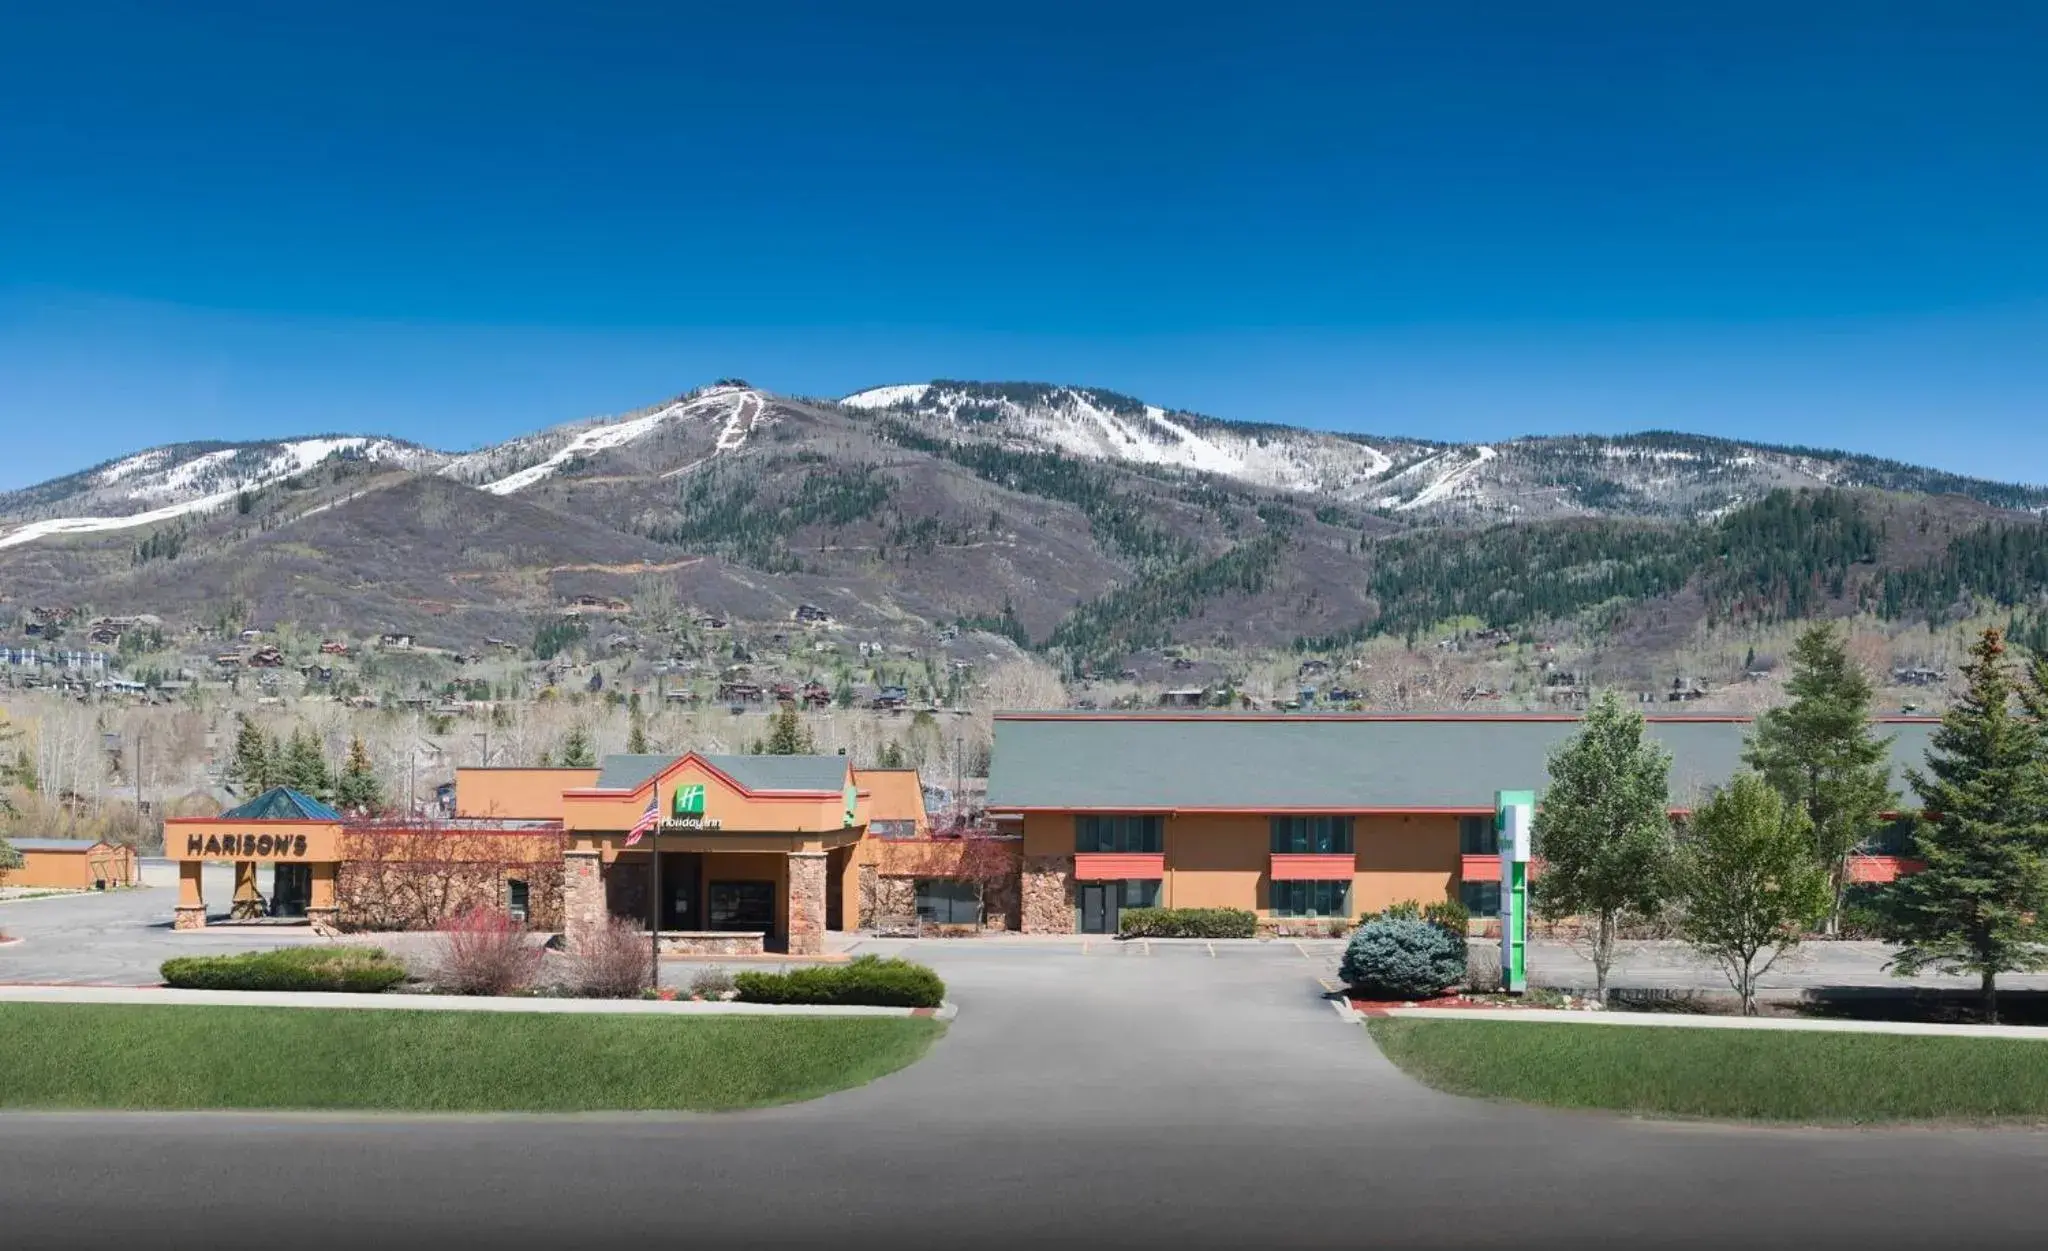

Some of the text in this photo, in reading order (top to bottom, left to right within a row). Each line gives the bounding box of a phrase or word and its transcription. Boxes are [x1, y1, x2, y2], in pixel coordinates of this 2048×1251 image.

[660, 816, 722, 830] Holiday Inn
[187, 834, 307, 857] HARISON'S
